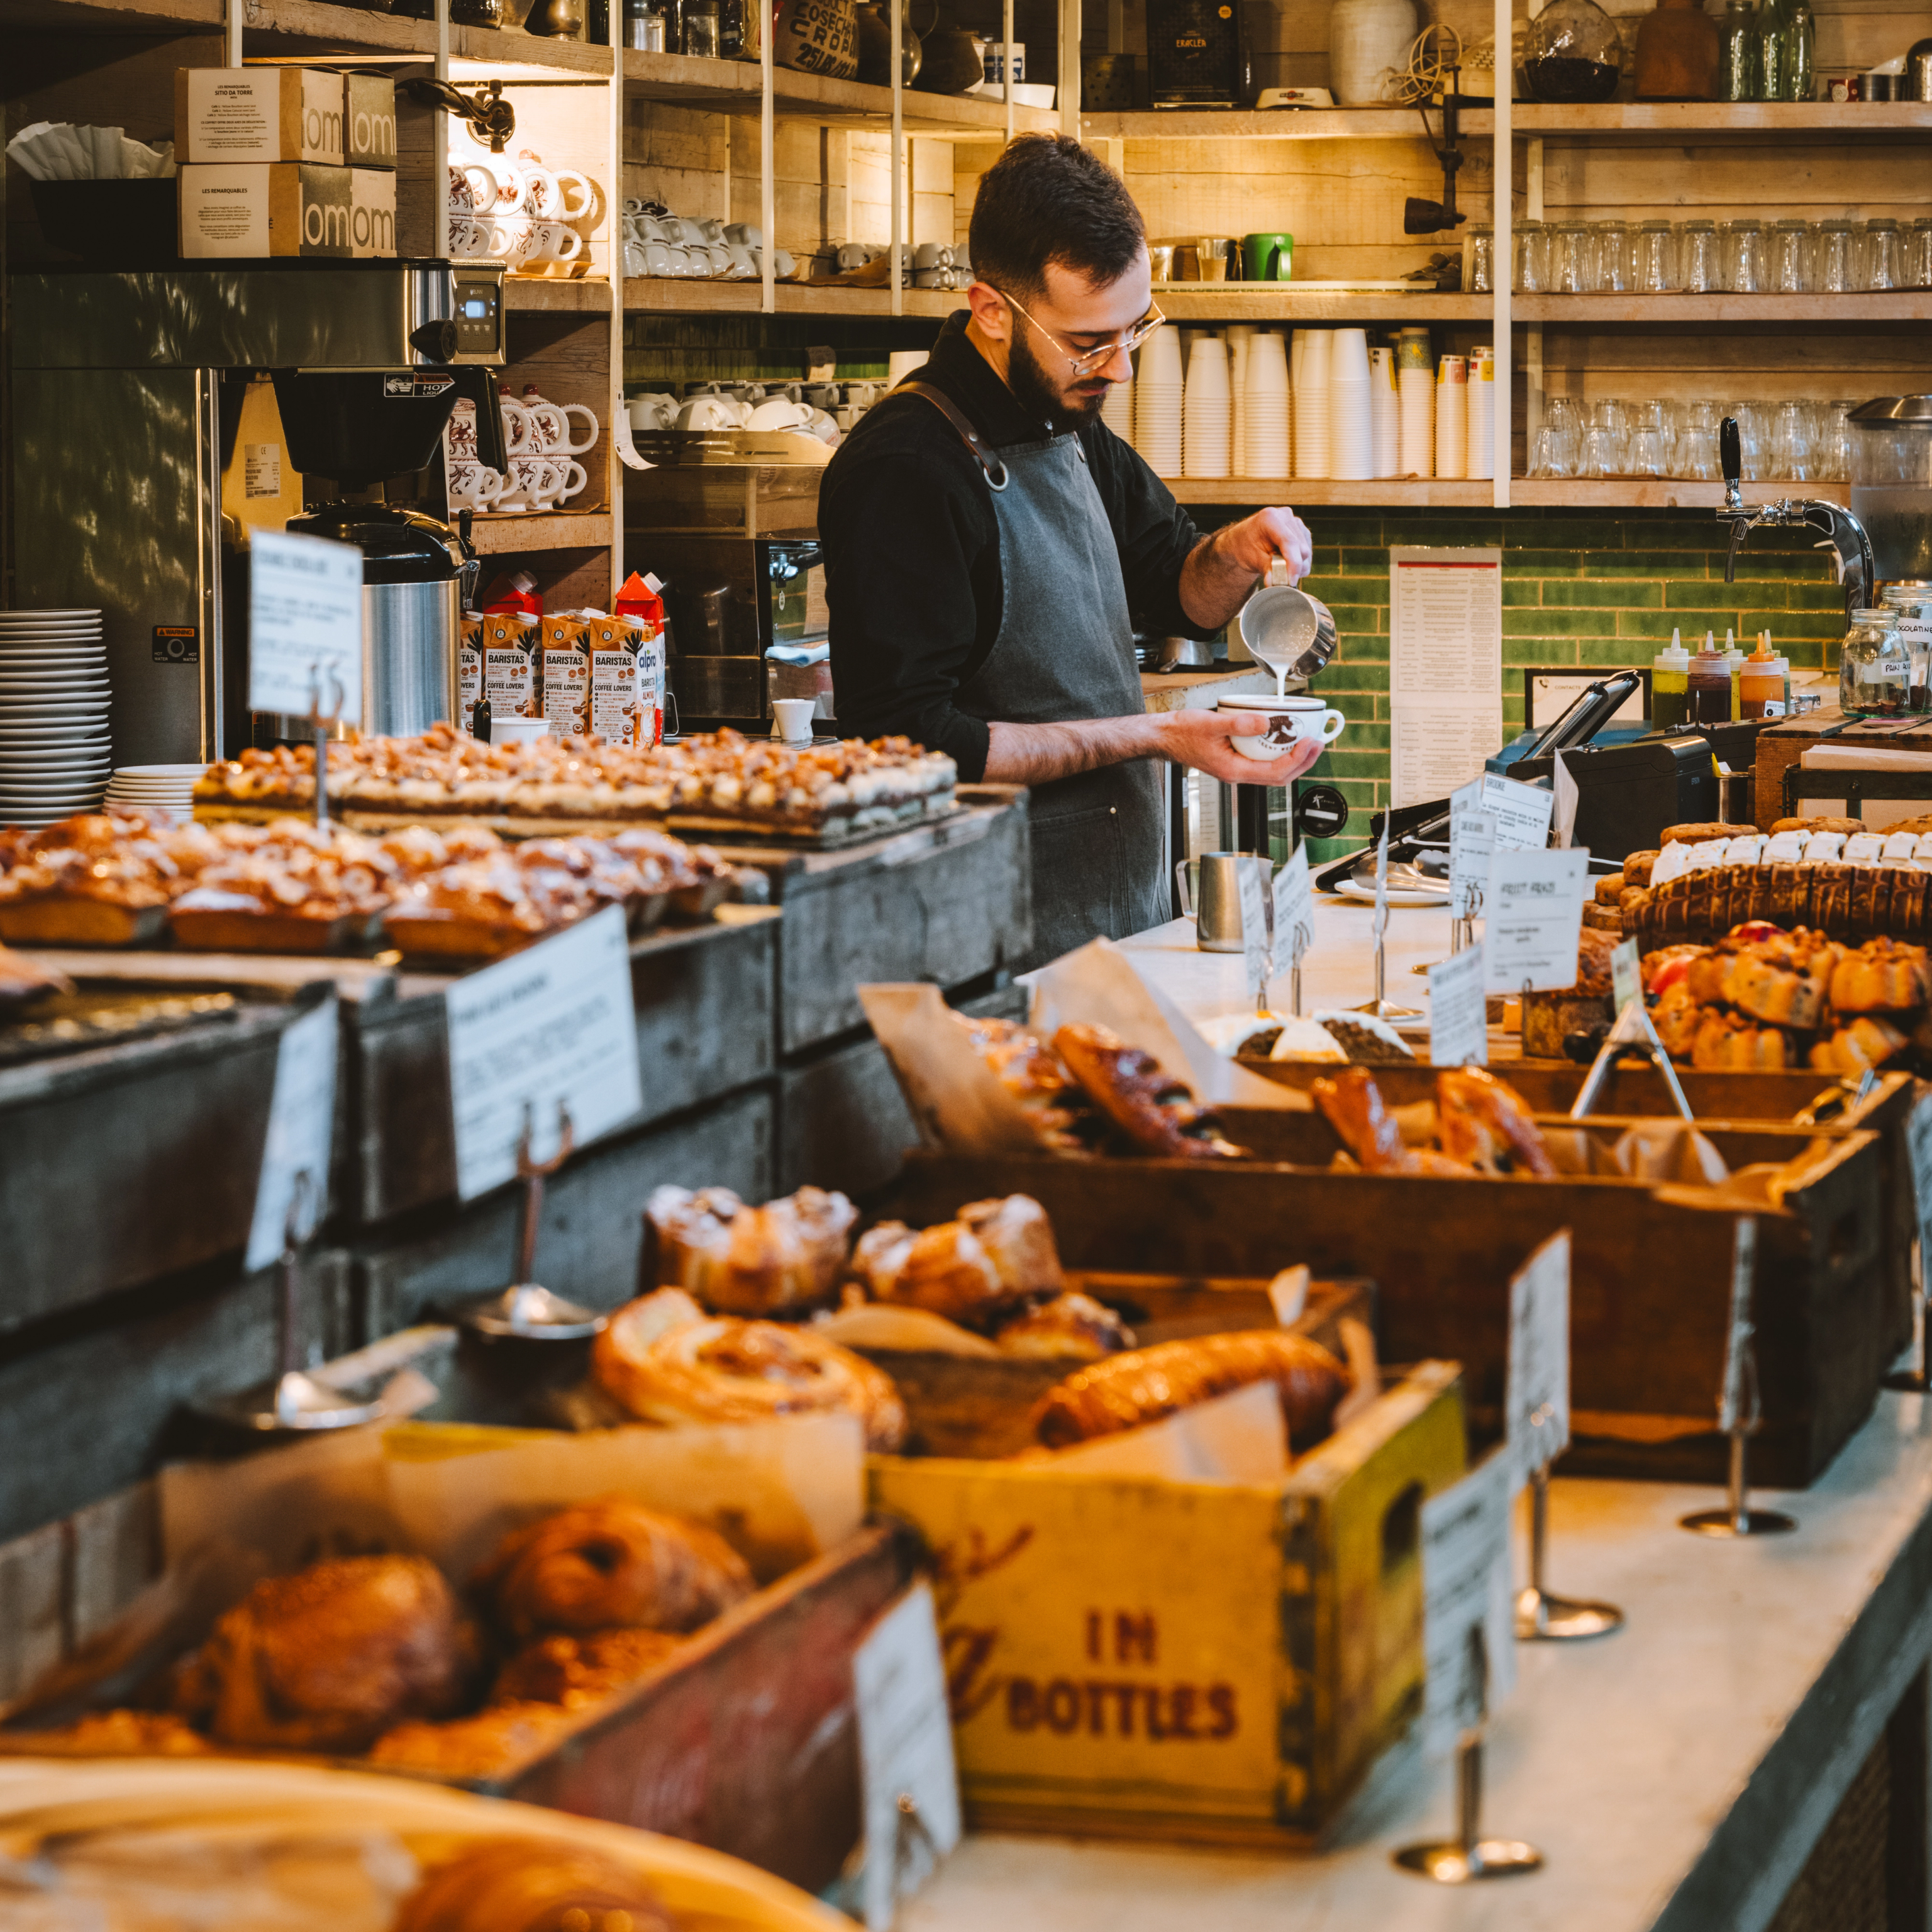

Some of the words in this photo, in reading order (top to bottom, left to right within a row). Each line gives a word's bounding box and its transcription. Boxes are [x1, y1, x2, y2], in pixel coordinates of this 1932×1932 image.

[1176, 39, 1206, 47] ERACLEA
[488, 655, 525, 663] BARISTAS
[546, 656, 583, 665] BARISTAS
[596, 657, 631, 666] BARISTAS
[639, 650, 656, 672] alpro
[1885, 664, 1899, 672] PAIN
[641, 677, 655, 687] BARISTA
[643, 691, 654, 700] ALMOND
[1485, 777, 1506, 792] BROOKIE
[1087, 1609, 1157, 1664] IN
[1009, 1678, 1236, 1740] BOTTLES
